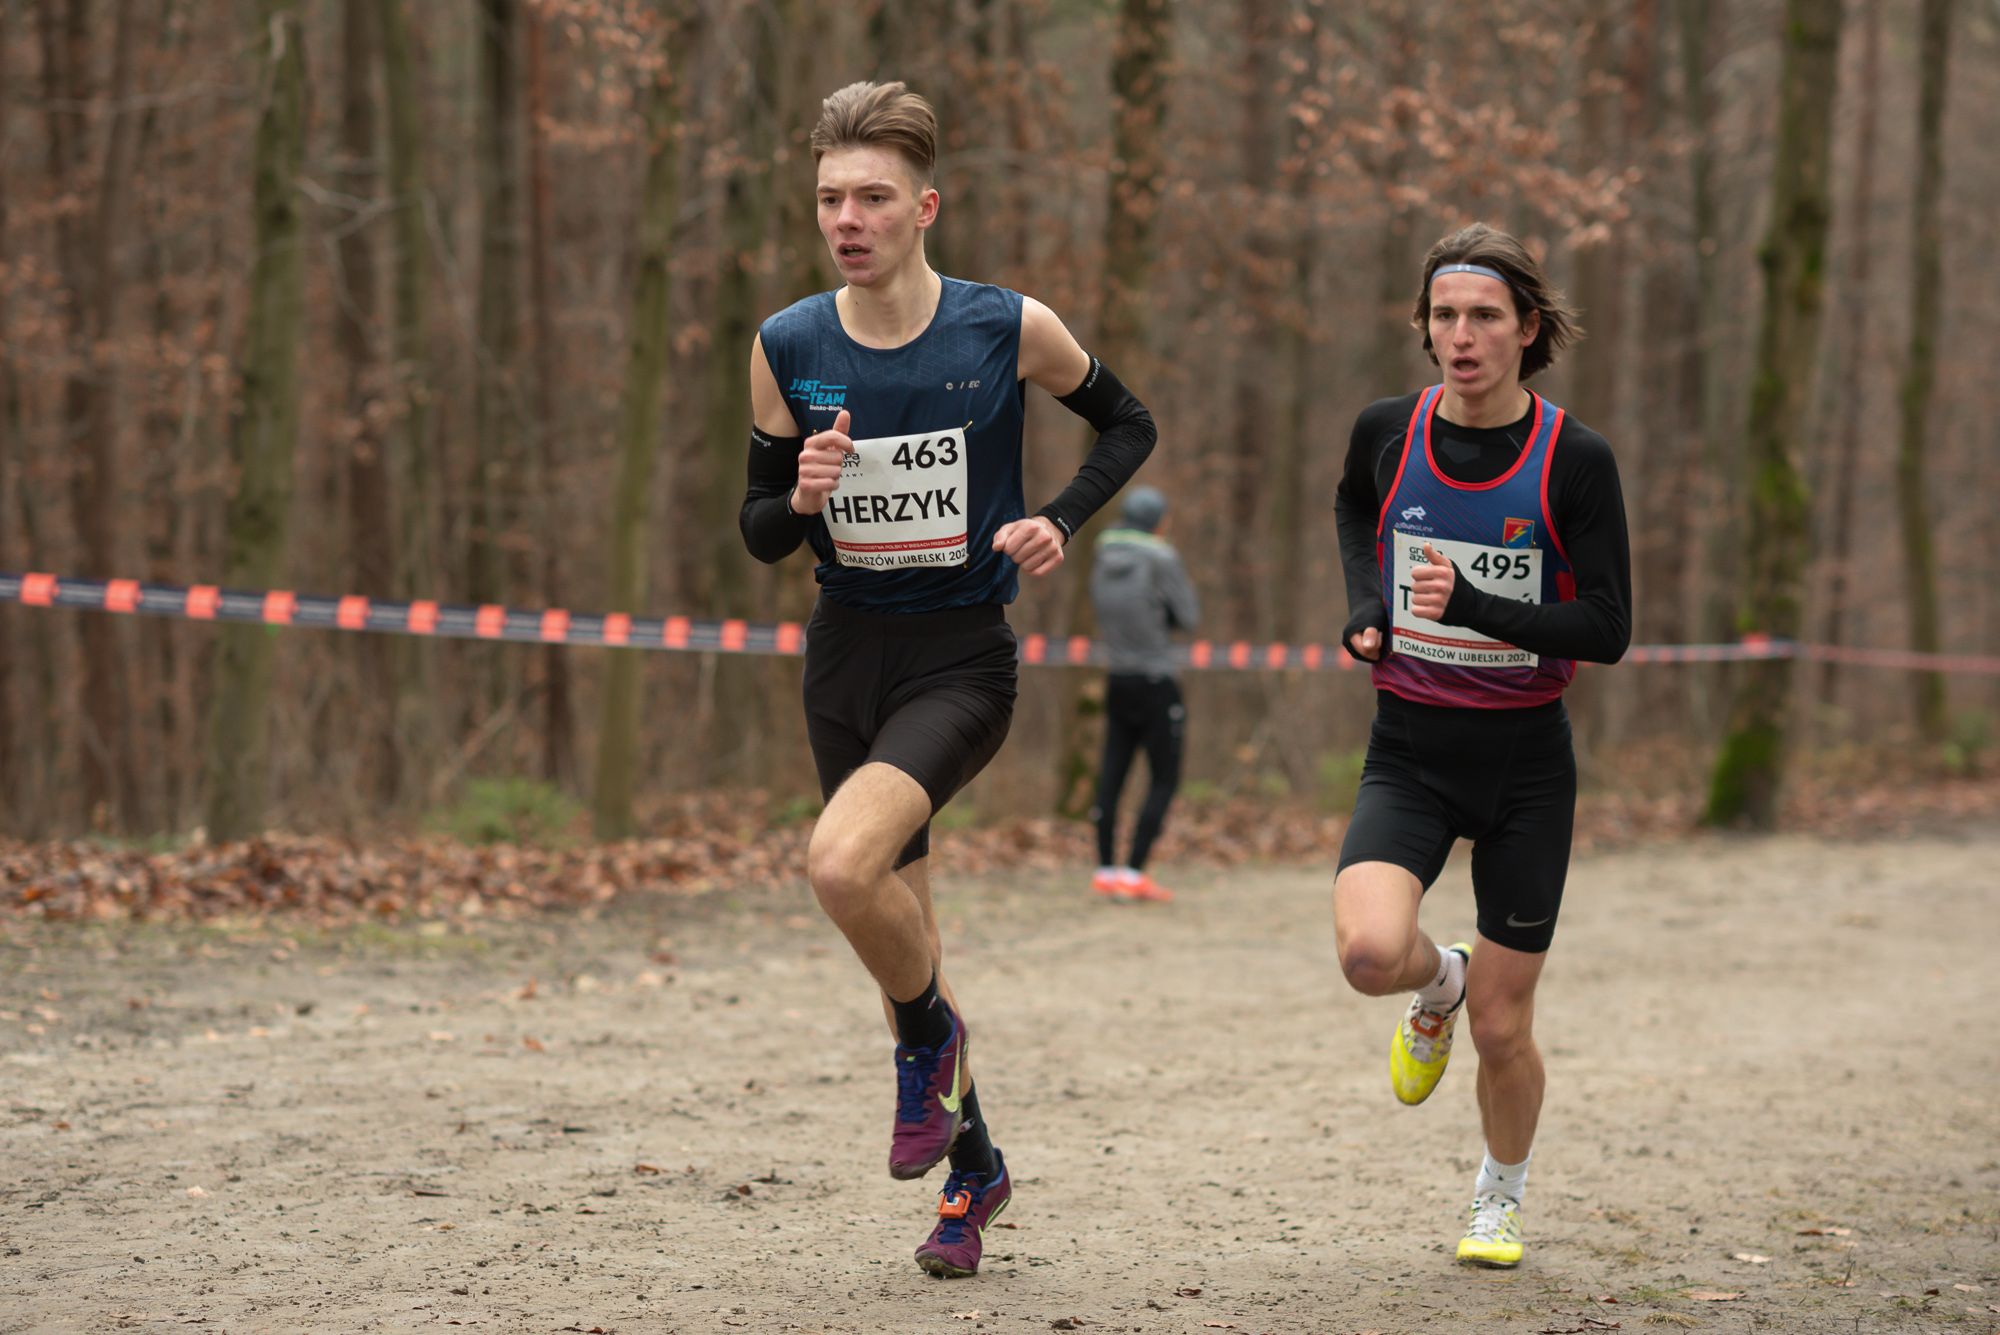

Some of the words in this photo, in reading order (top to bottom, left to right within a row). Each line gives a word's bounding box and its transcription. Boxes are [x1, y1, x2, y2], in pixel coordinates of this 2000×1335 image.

[790, 378, 820, 392] JUST
[810, 392, 846, 405] TEAM
[892, 436, 958, 470] 463
[829, 487, 960, 524] HERZYK
[838, 552, 894, 566] TOMASZÓW
[898, 552, 945, 564] LUBELSKI
[1471, 552, 1530, 580] 495
[1399, 640, 1456, 660] TOMASZÓW
[1459, 652, 1504, 662] LUBELSKI
[1507, 653, 1530, 662] 2021
